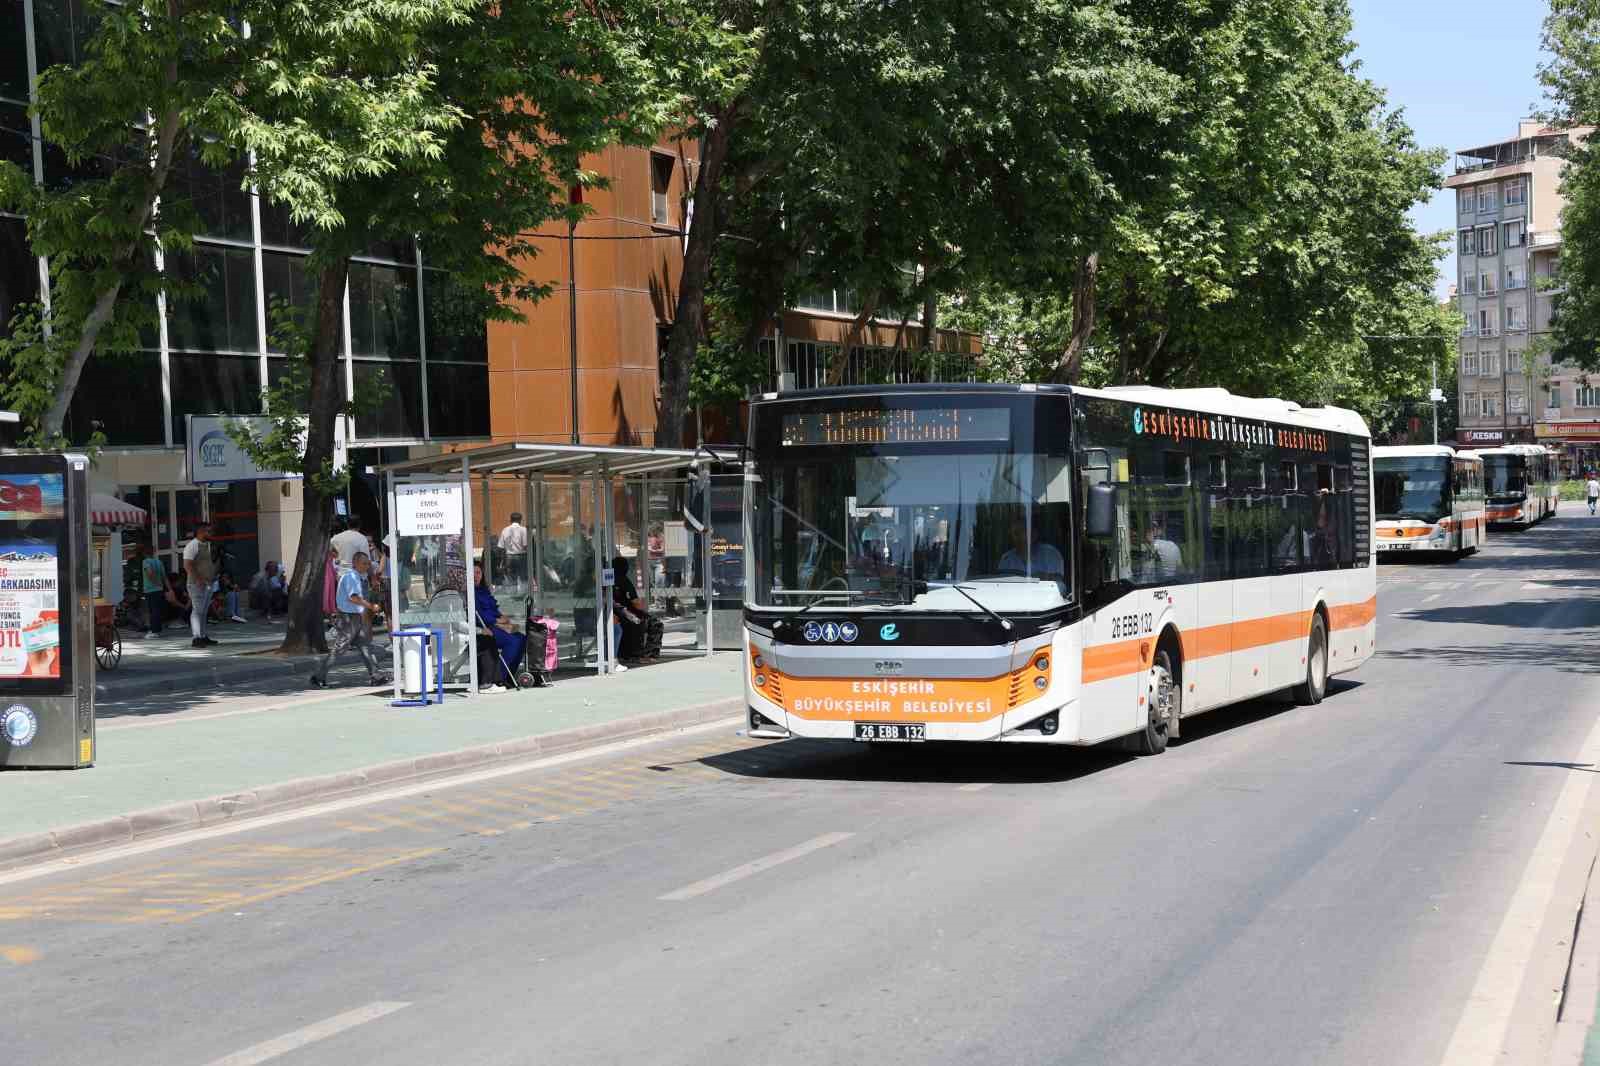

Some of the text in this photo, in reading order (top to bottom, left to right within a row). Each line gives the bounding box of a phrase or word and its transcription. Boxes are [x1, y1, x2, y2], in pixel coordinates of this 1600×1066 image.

[1143, 408, 1210, 442] ESKİŞEHİR
[1210, 415, 1275, 449] BÜYÜKŞEHİR
[1278, 428, 1328, 452] BELEDİYESİ
[1112, 612, 1153, 639] 26 EBB 132
[852, 680, 935, 696] ESKİŞEHİR
[794, 698, 992, 713] BÜYÜKŞEHİR BELEDİYESİ
[861, 725, 924, 738] 26 EBB 132
